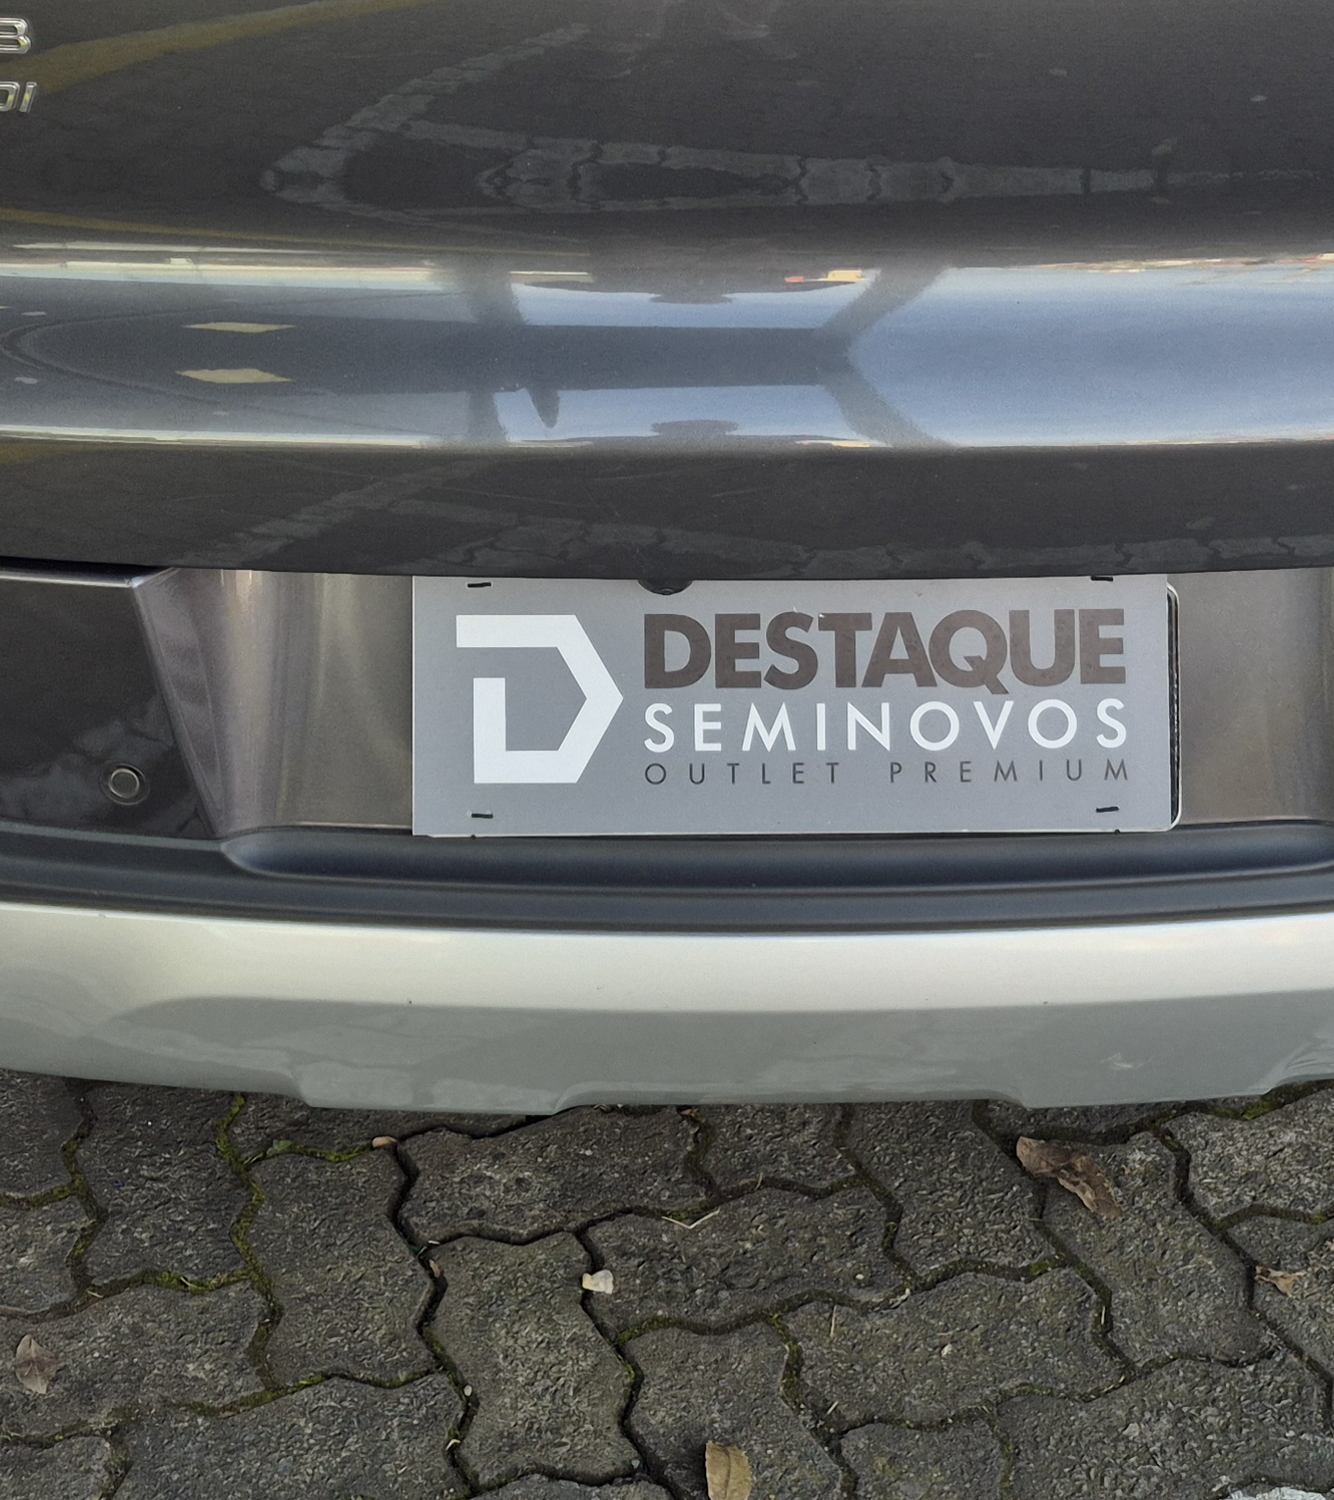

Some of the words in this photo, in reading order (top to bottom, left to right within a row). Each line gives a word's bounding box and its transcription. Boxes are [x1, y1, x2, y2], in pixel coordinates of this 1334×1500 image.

[643, 608, 1127, 695] DESTAQUE
[643, 698, 1128, 753] SEMINOVOS
[645, 761, 839, 786] OUTLET
[890, 759, 1130, 784] PREMIUM
